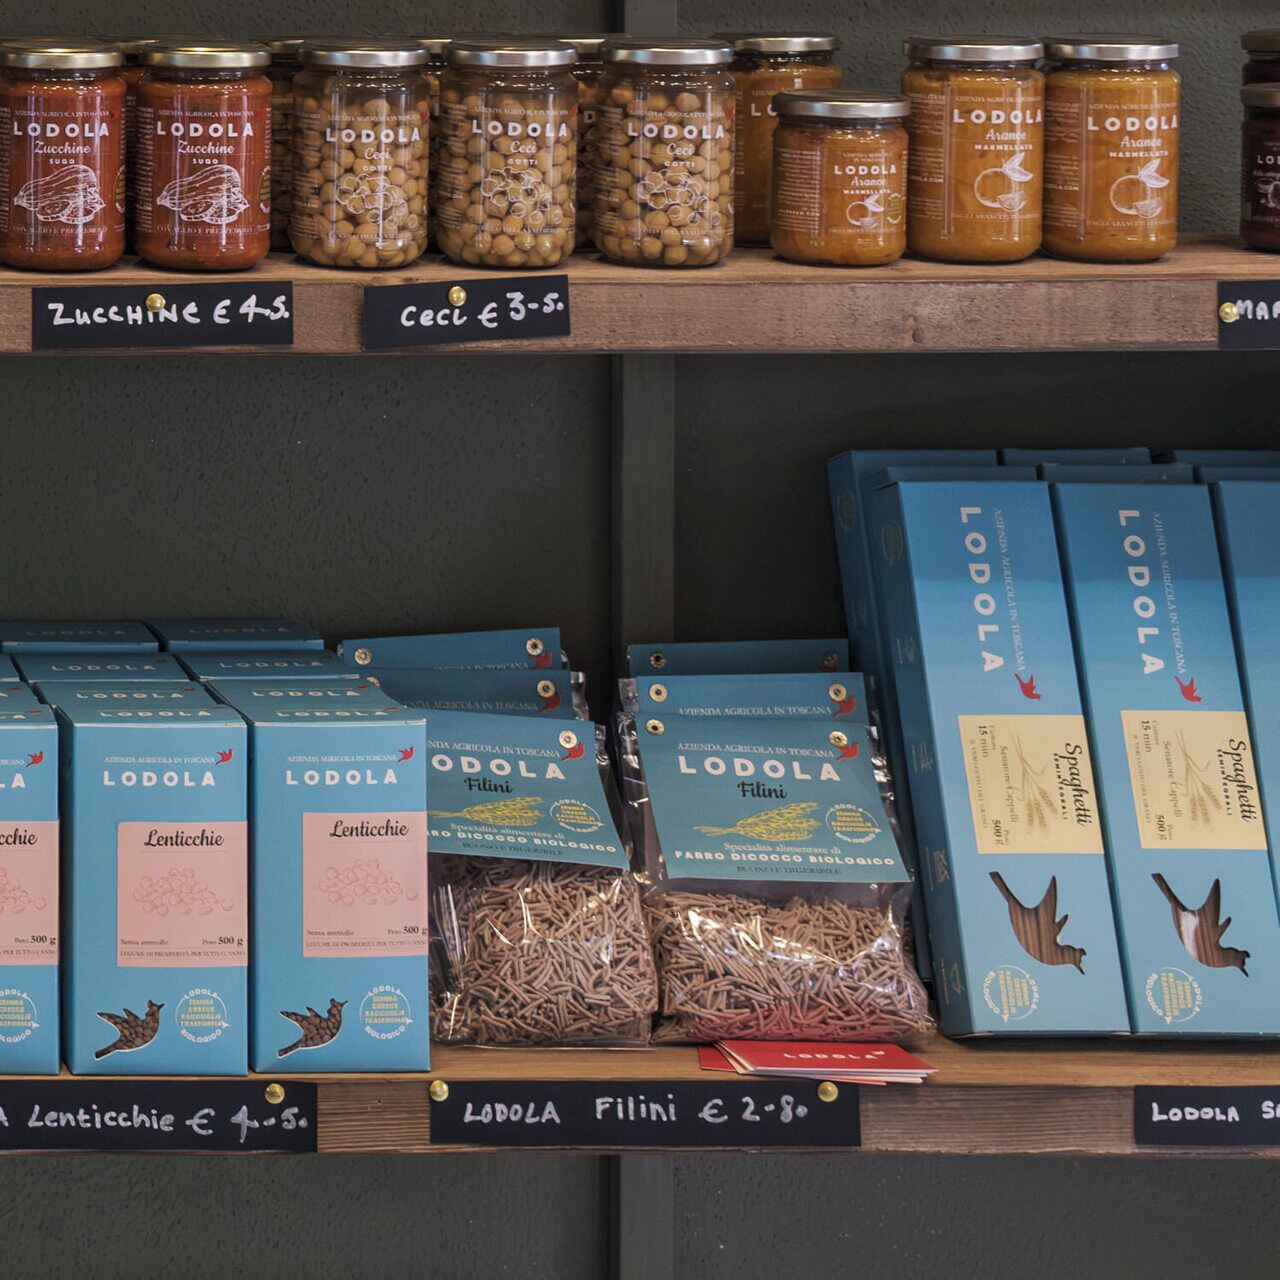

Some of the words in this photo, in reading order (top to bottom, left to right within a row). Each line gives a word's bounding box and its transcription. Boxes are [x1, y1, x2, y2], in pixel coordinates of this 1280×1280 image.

[13, 122, 109, 137] LODOLA
[156, 122, 254, 137] LODOLA
[472, 120, 567, 137] LODOLA
[627, 123, 725, 139] LODOLA
[1087, 115, 1178, 131] LODOLA
[326, 127, 420, 143] LODOLA
[34, 140, 90, 155] Zucchine
[177, 140, 234, 155] Zucchine
[959, 506, 1005, 673] LODOLA
[1118, 508, 1165, 675] LODOLA
[431, 754, 566, 780] ODOLA
[677, 755, 841, 782] LODOLA
[103, 770, 215, 787] LODOLA
[286, 769, 398, 785] LODOLA
[464, 777, 513, 794] Filini
[1064, 741, 1093, 827] Spaghetti
[1227, 738, 1258, 823] Spaghetti
[737, 781, 788, 800] Filini
[329, 819, 409, 839] Lenticchie
[143, 829, 224, 848] Lenticchie
[783, 1052, 877, 1061] LODOLA
[462, 1100, 561, 1125] LODOLA
[595, 1093, 677, 1124] Filini
[698, 1098, 728, 1123] €
[1152, 1103, 1240, 1124] LODOLA
[27, 1104, 176, 1132] Lenticchie
[185, 1107, 215, 1136] €
